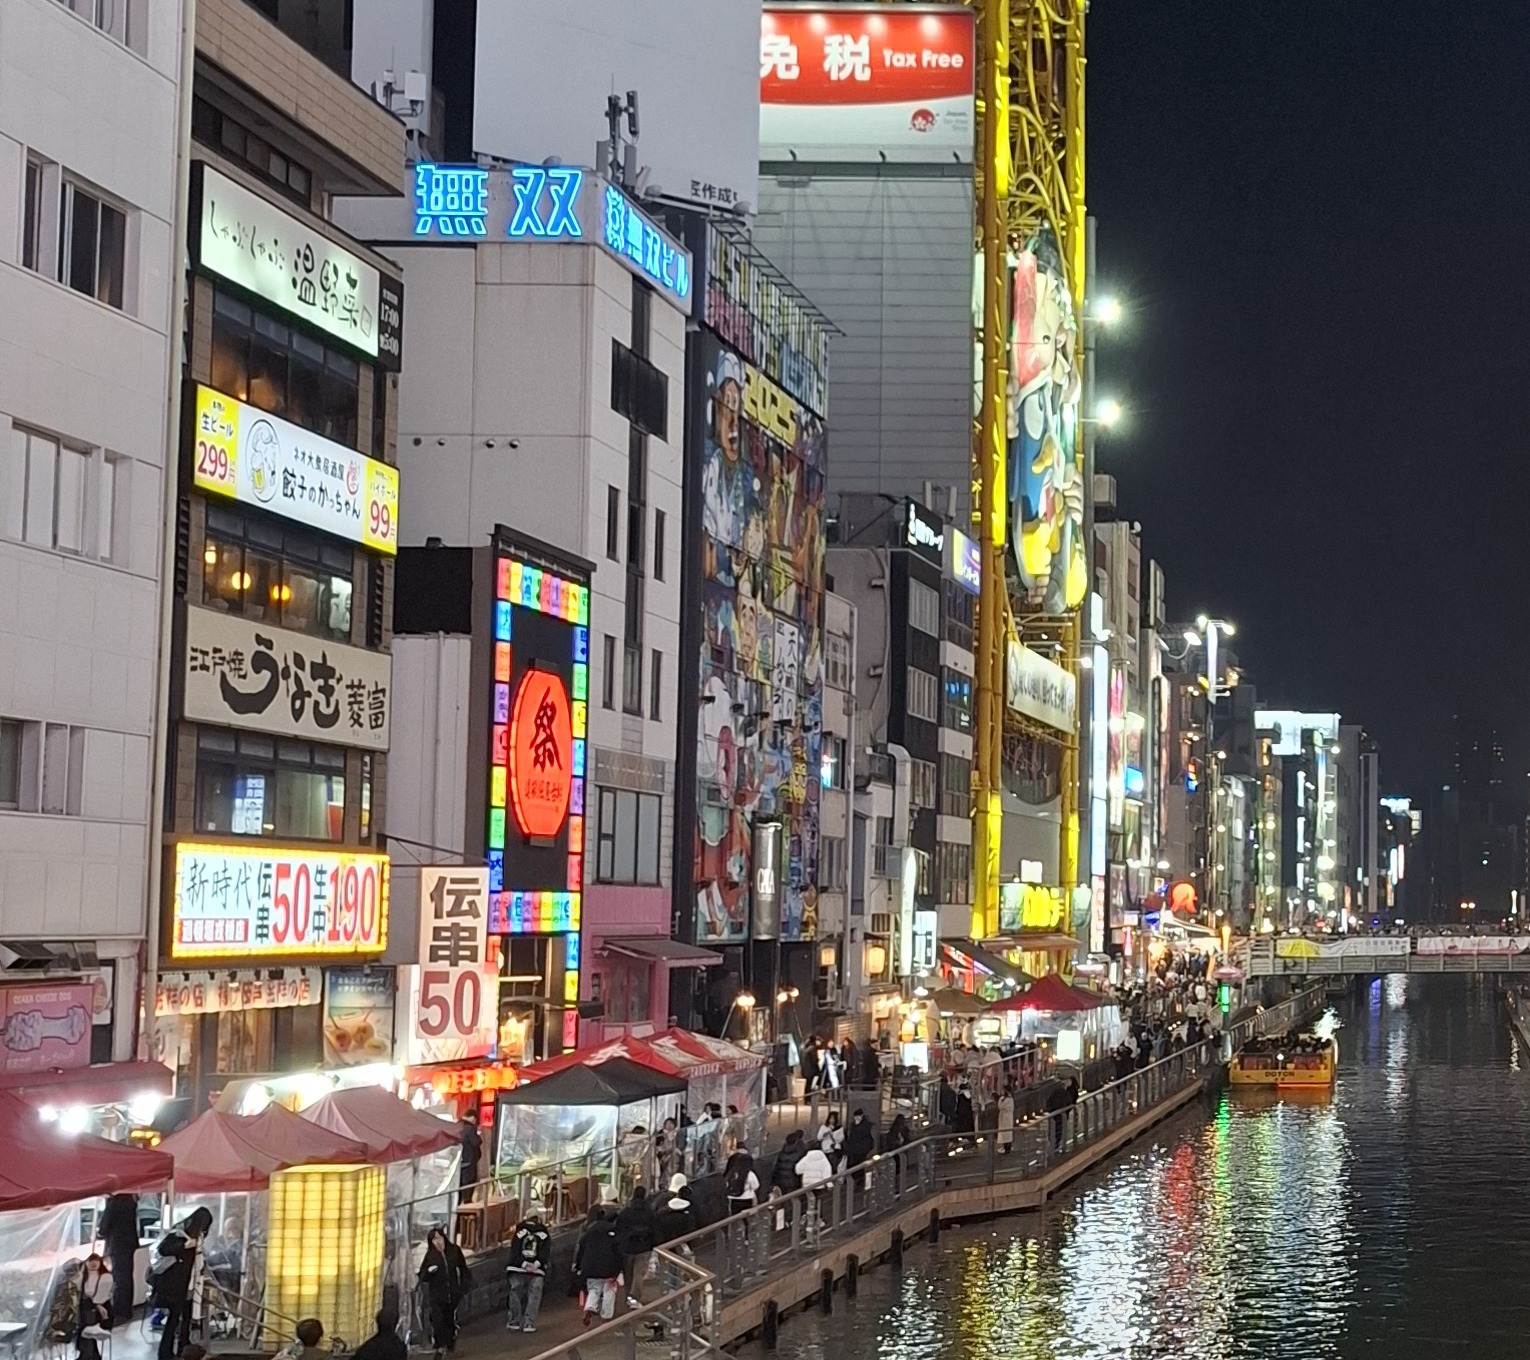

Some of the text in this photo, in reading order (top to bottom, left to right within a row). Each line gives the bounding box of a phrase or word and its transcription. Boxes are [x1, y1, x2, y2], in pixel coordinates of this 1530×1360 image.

[882, 48, 916, 69] Tax
[921, 49, 964, 69] Free
[210, 200, 286, 272] しゃぶしゃぶ
[415, 163, 582, 237] 無双
[201, 413, 234, 437] 生ビール
[281, 466, 362, 520] 餃子のかっちゃん
[189, 632, 387, 730] 江戸焼 うなぎ 菱富
[186, 856, 376, 944] 新時代 伝串 50 生中 190
[428, 876, 482, 968] 伝串
[419, 970, 481, 1037] 50
